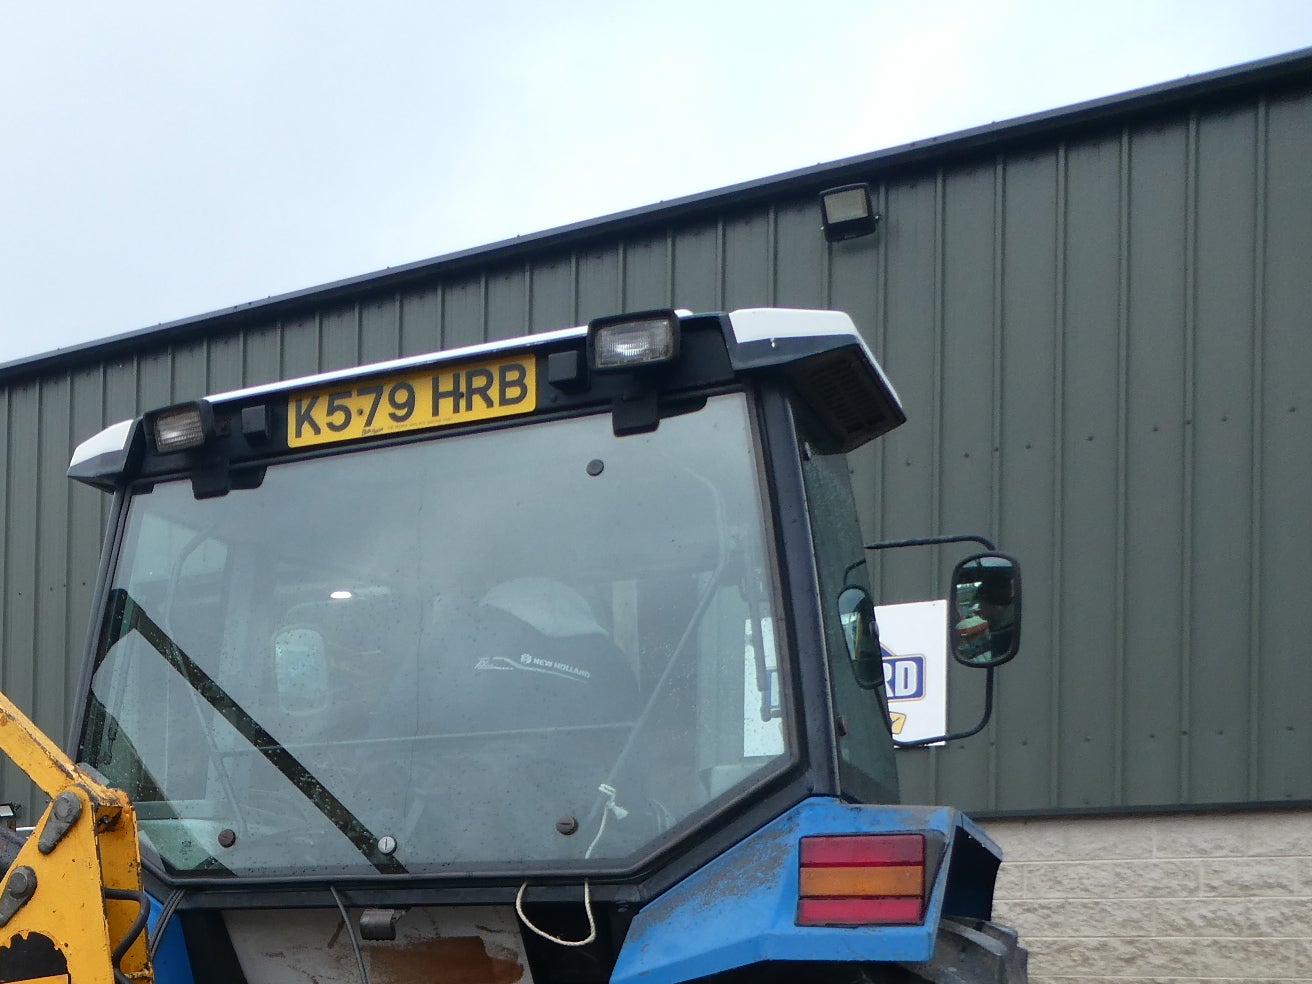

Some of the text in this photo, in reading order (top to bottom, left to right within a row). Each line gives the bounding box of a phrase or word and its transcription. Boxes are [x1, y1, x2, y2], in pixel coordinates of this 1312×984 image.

[294, 363, 528, 439] K579 HRB
[533, 658, 591, 678] NEW HOLLAND
